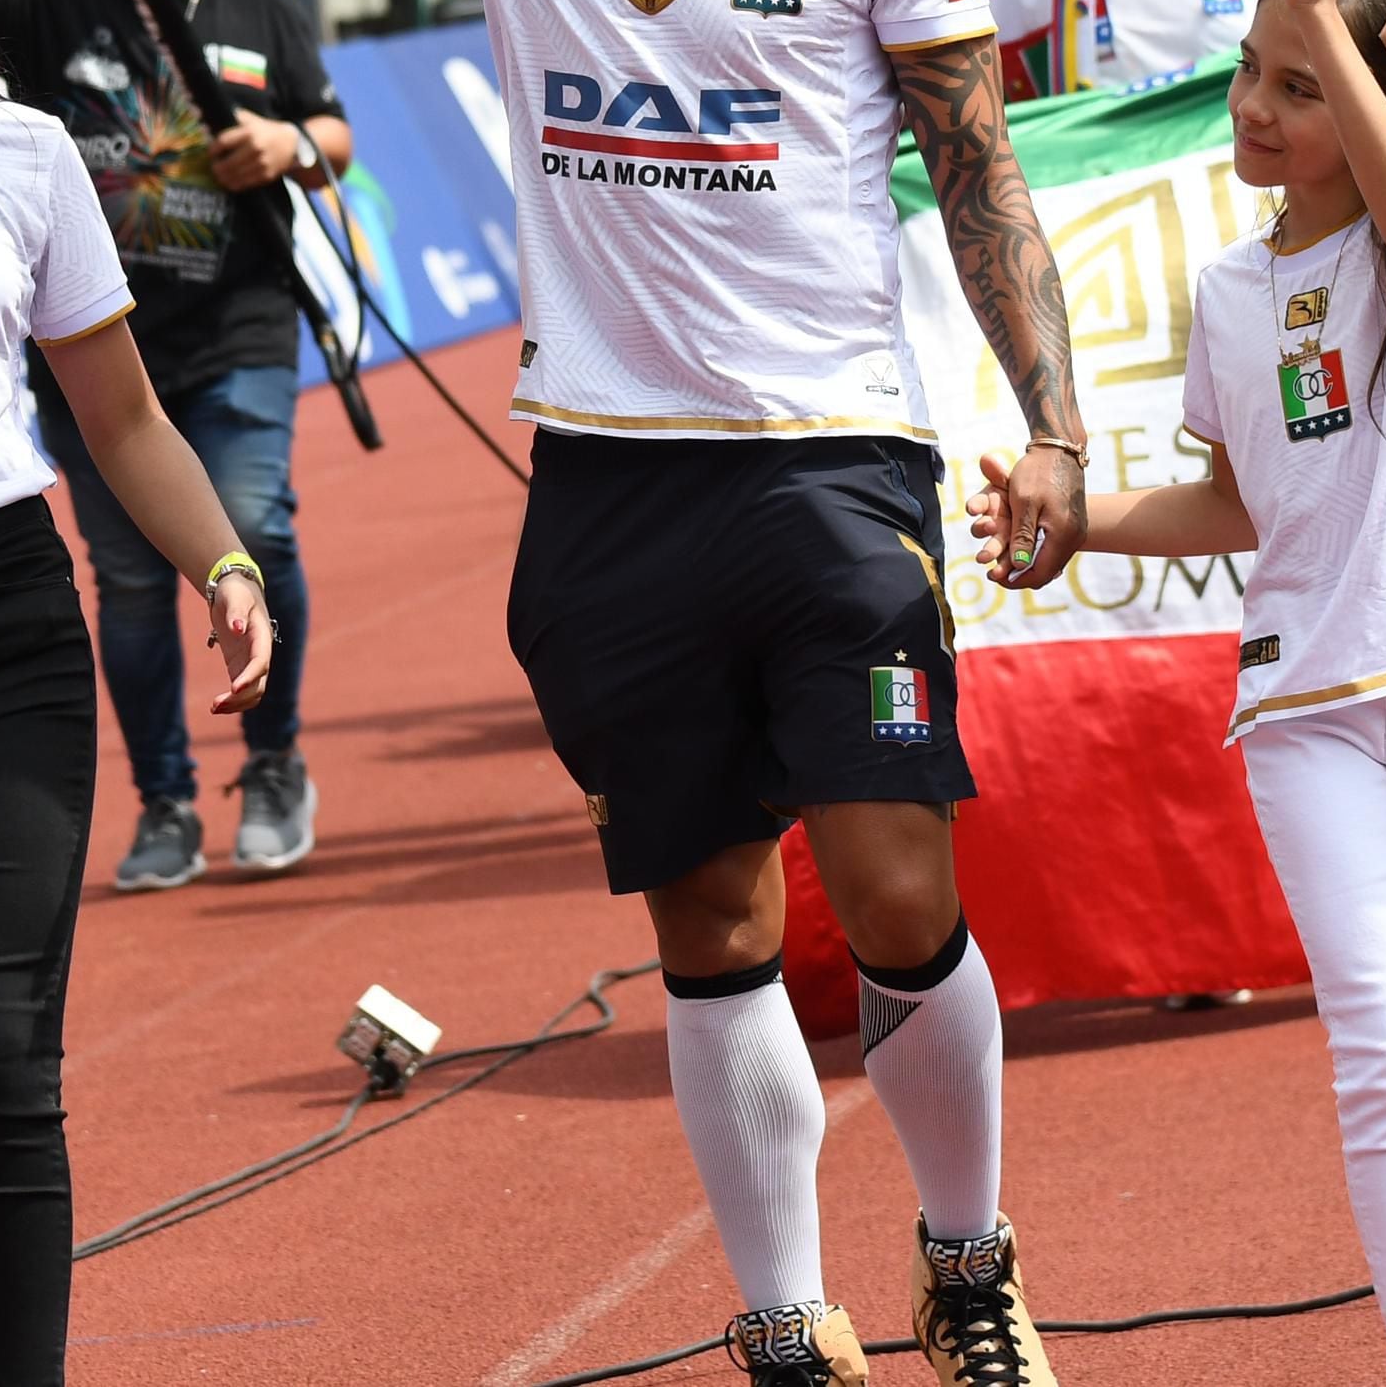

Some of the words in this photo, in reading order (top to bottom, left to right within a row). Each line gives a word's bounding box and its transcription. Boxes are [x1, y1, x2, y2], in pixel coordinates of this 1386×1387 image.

[543, 69, 781, 135] DAF
[542, 152, 570, 178] DE
[578, 157, 608, 183] LA
[614, 162, 777, 192] MONTAÑA
